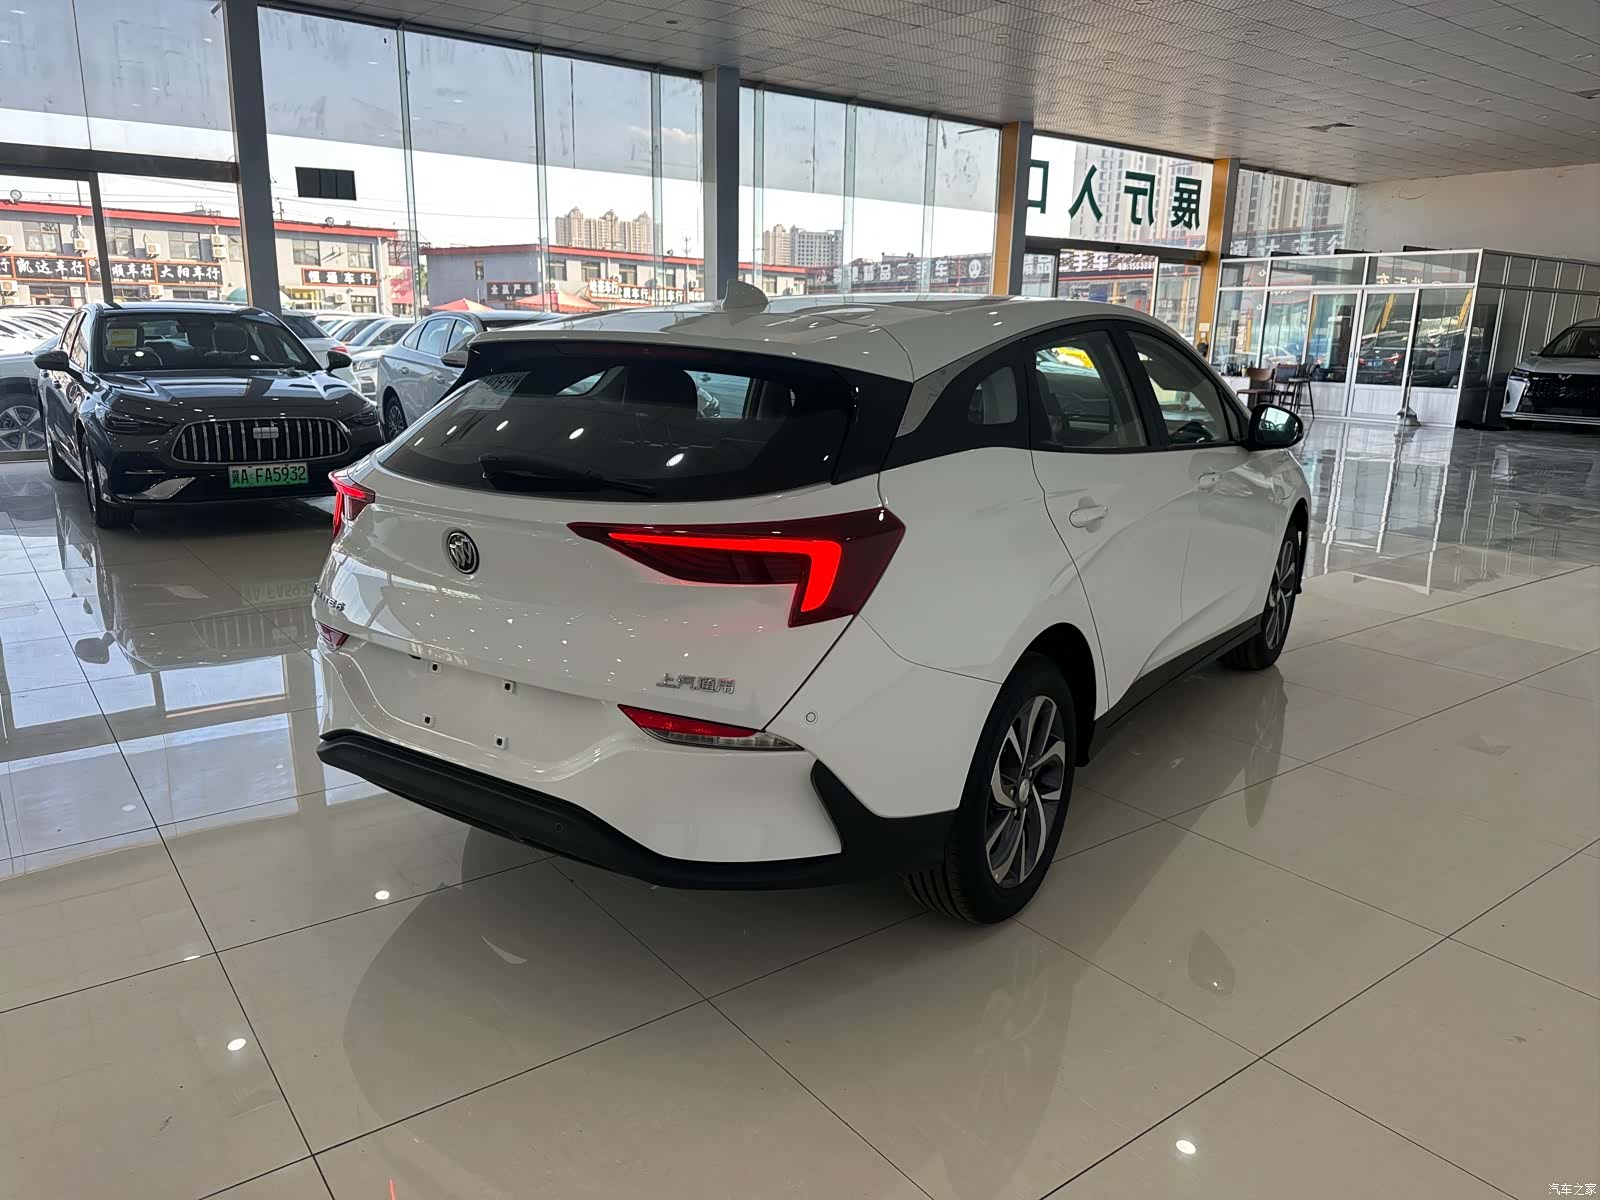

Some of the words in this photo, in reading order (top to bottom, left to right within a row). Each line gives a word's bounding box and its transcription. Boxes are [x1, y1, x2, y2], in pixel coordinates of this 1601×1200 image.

[16, 257, 85, 276] 凯达车行
[97, 262, 153, 279] 顺车行
[308, 270, 372, 285] 恒通车行
[656, 672, 736, 694] 上汽通用
